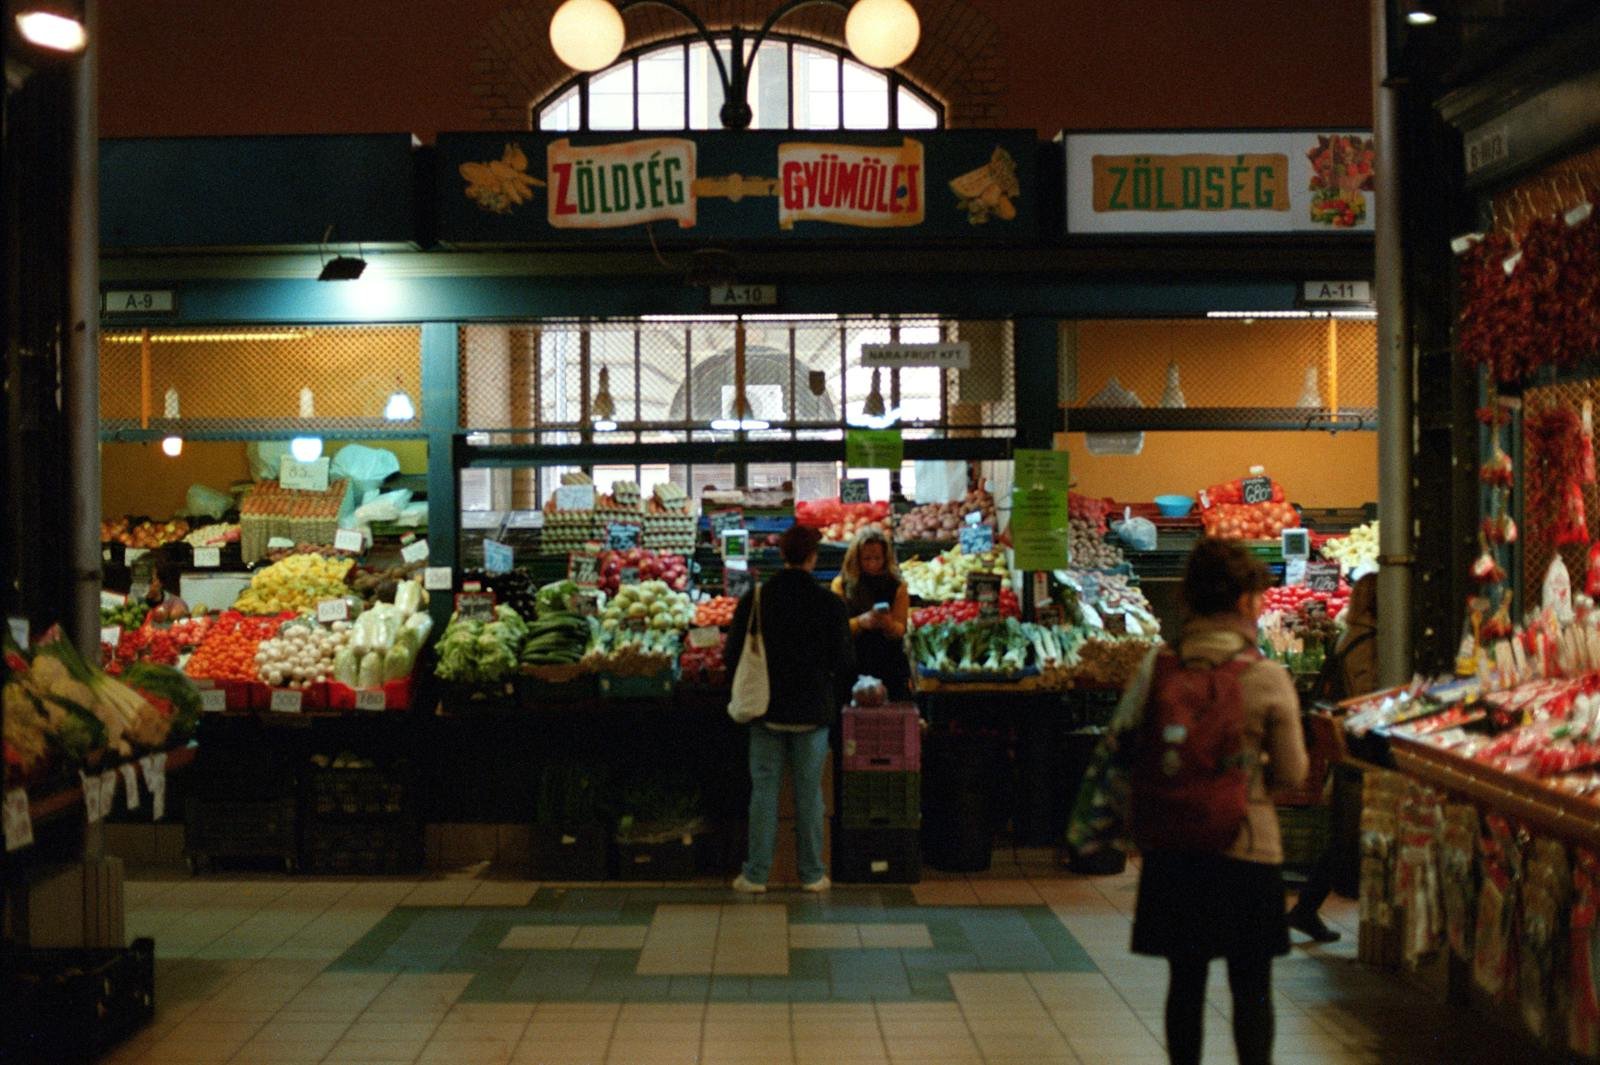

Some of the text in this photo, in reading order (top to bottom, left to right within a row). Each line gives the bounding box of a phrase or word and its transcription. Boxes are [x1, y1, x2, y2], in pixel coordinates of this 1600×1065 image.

[553, 151, 684, 215] ZÖLDSÉG
[783, 154, 919, 213] GYÜMÖLCS
[1107, 155, 1275, 209] ZÖLDSÉG
[126, 294, 153, 308] A-9
[724, 287, 762, 302] A-10
[1319, 284, 1353, 298] A-11
